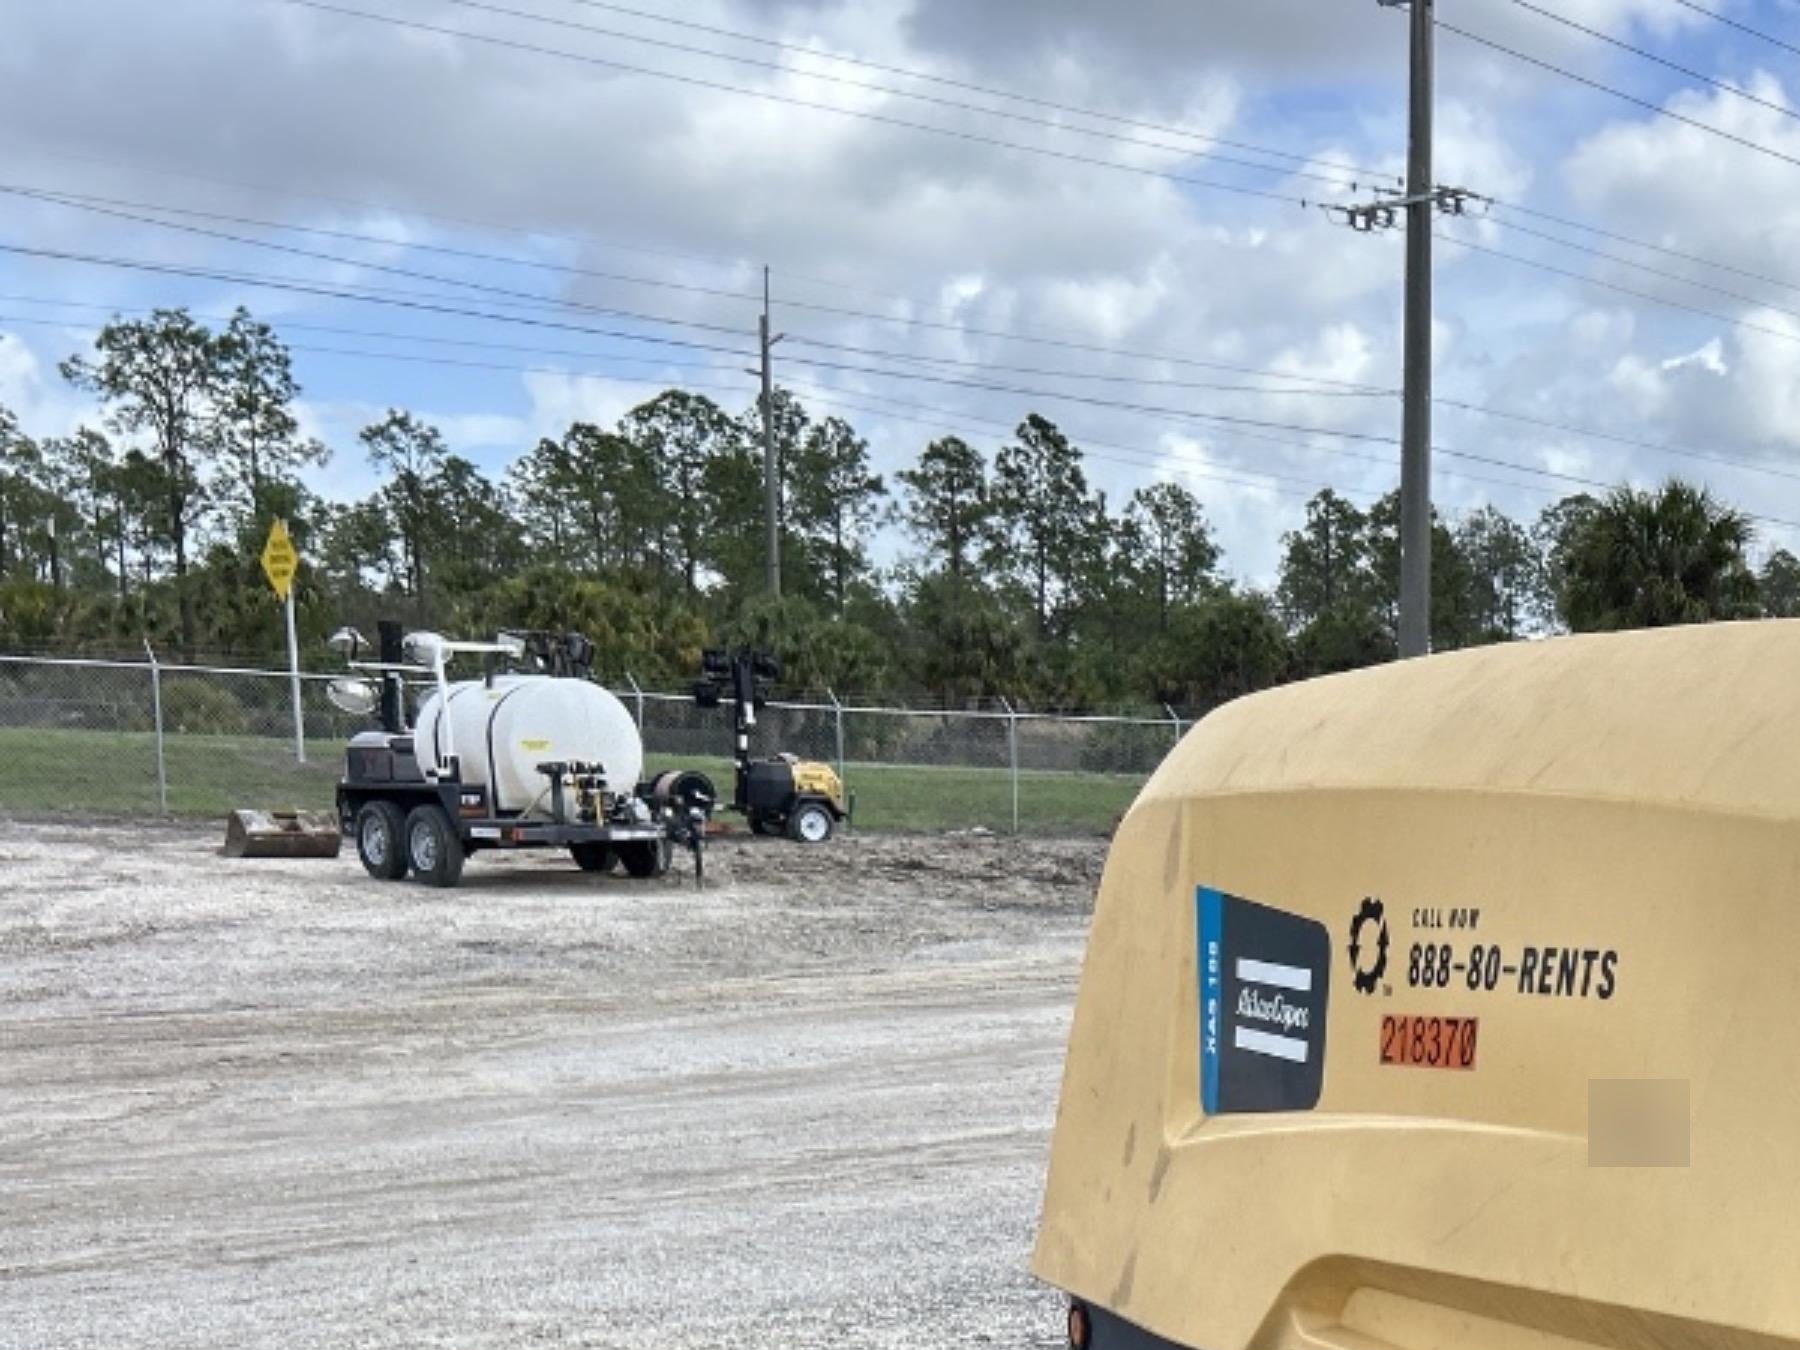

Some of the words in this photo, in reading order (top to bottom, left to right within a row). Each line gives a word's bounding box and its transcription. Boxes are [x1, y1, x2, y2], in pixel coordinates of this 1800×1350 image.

[1412, 908, 1443, 929] CALL
[1448, 907, 1481, 929] NOW
[1408, 942, 1619, 1000] 888-80-RENTS
[1380, 1015, 1478, 1068] 218370
